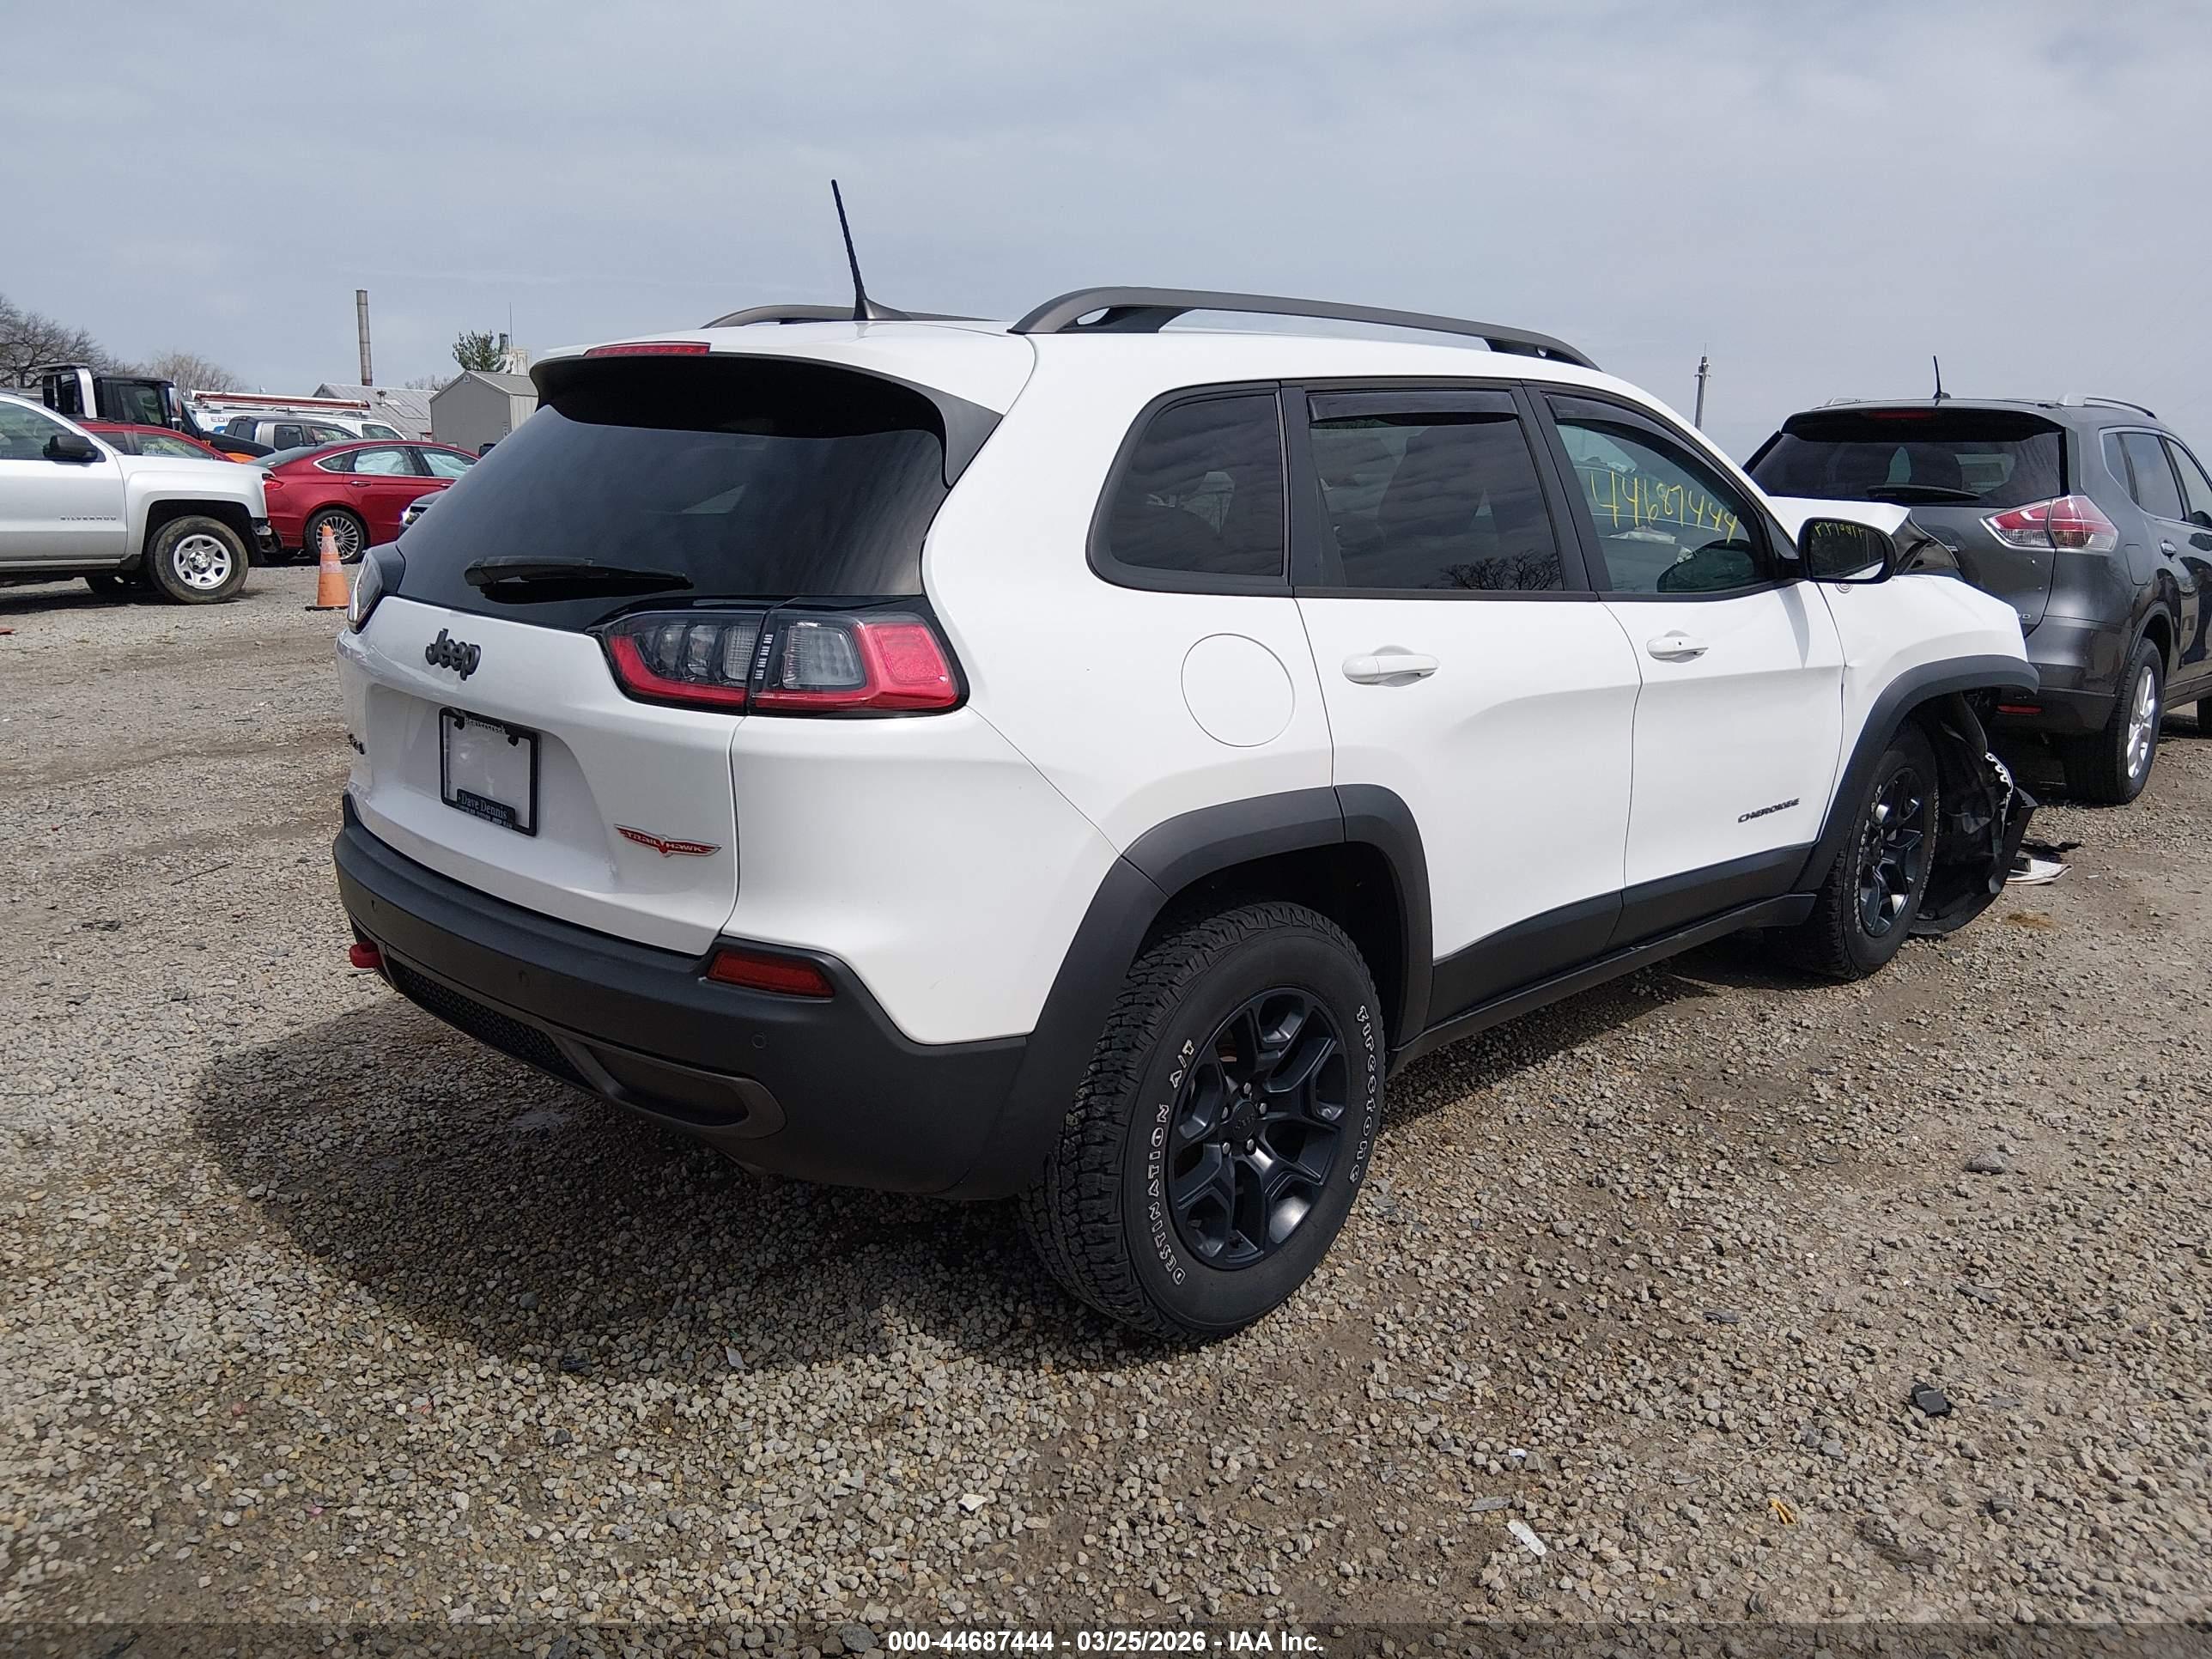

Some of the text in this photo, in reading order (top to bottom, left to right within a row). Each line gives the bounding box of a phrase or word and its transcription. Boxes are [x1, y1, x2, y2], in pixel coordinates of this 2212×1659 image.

[1590, 470, 1738, 544] 44687444
[461, 792, 480, 809] Dave
[480, 799, 508, 820] Dennis
[1737, 797, 1801, 823] CHEROKEE
[1148, 1038, 1195, 1285] DESTINATION A/T
